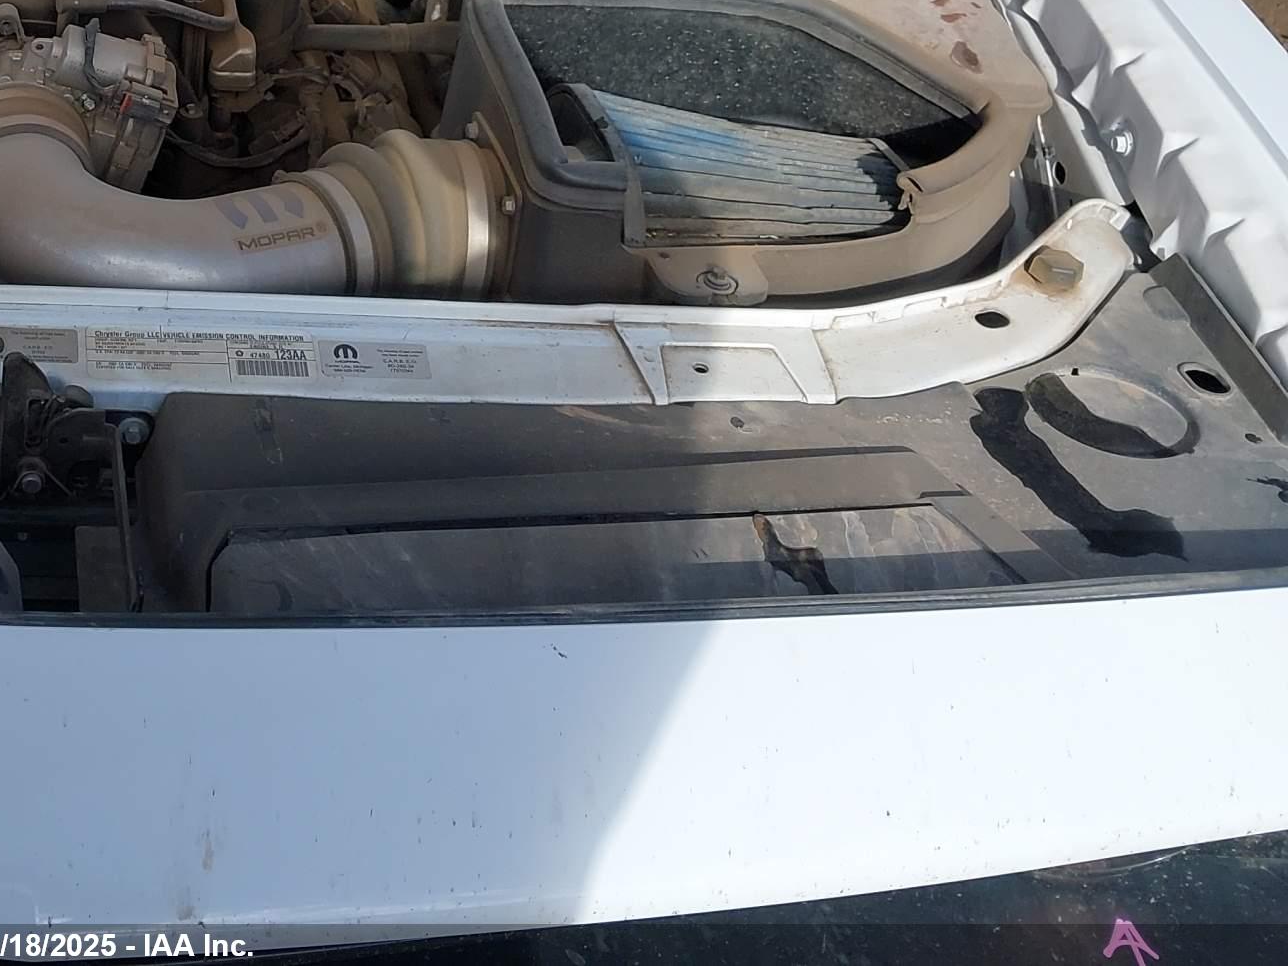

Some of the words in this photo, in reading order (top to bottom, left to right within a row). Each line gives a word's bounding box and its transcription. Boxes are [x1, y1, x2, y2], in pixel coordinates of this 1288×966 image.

[237, 226, 315, 251] MOPAR
[94, 330, 122, 338] Chrysler
[125, 331, 145, 339] Group
[163, 331, 190, 339] VEHICLE
[225, 333, 256, 341] CONTROL
[258, 334, 304, 342] INFORMATION
[274, 349, 307, 361] 123AA
